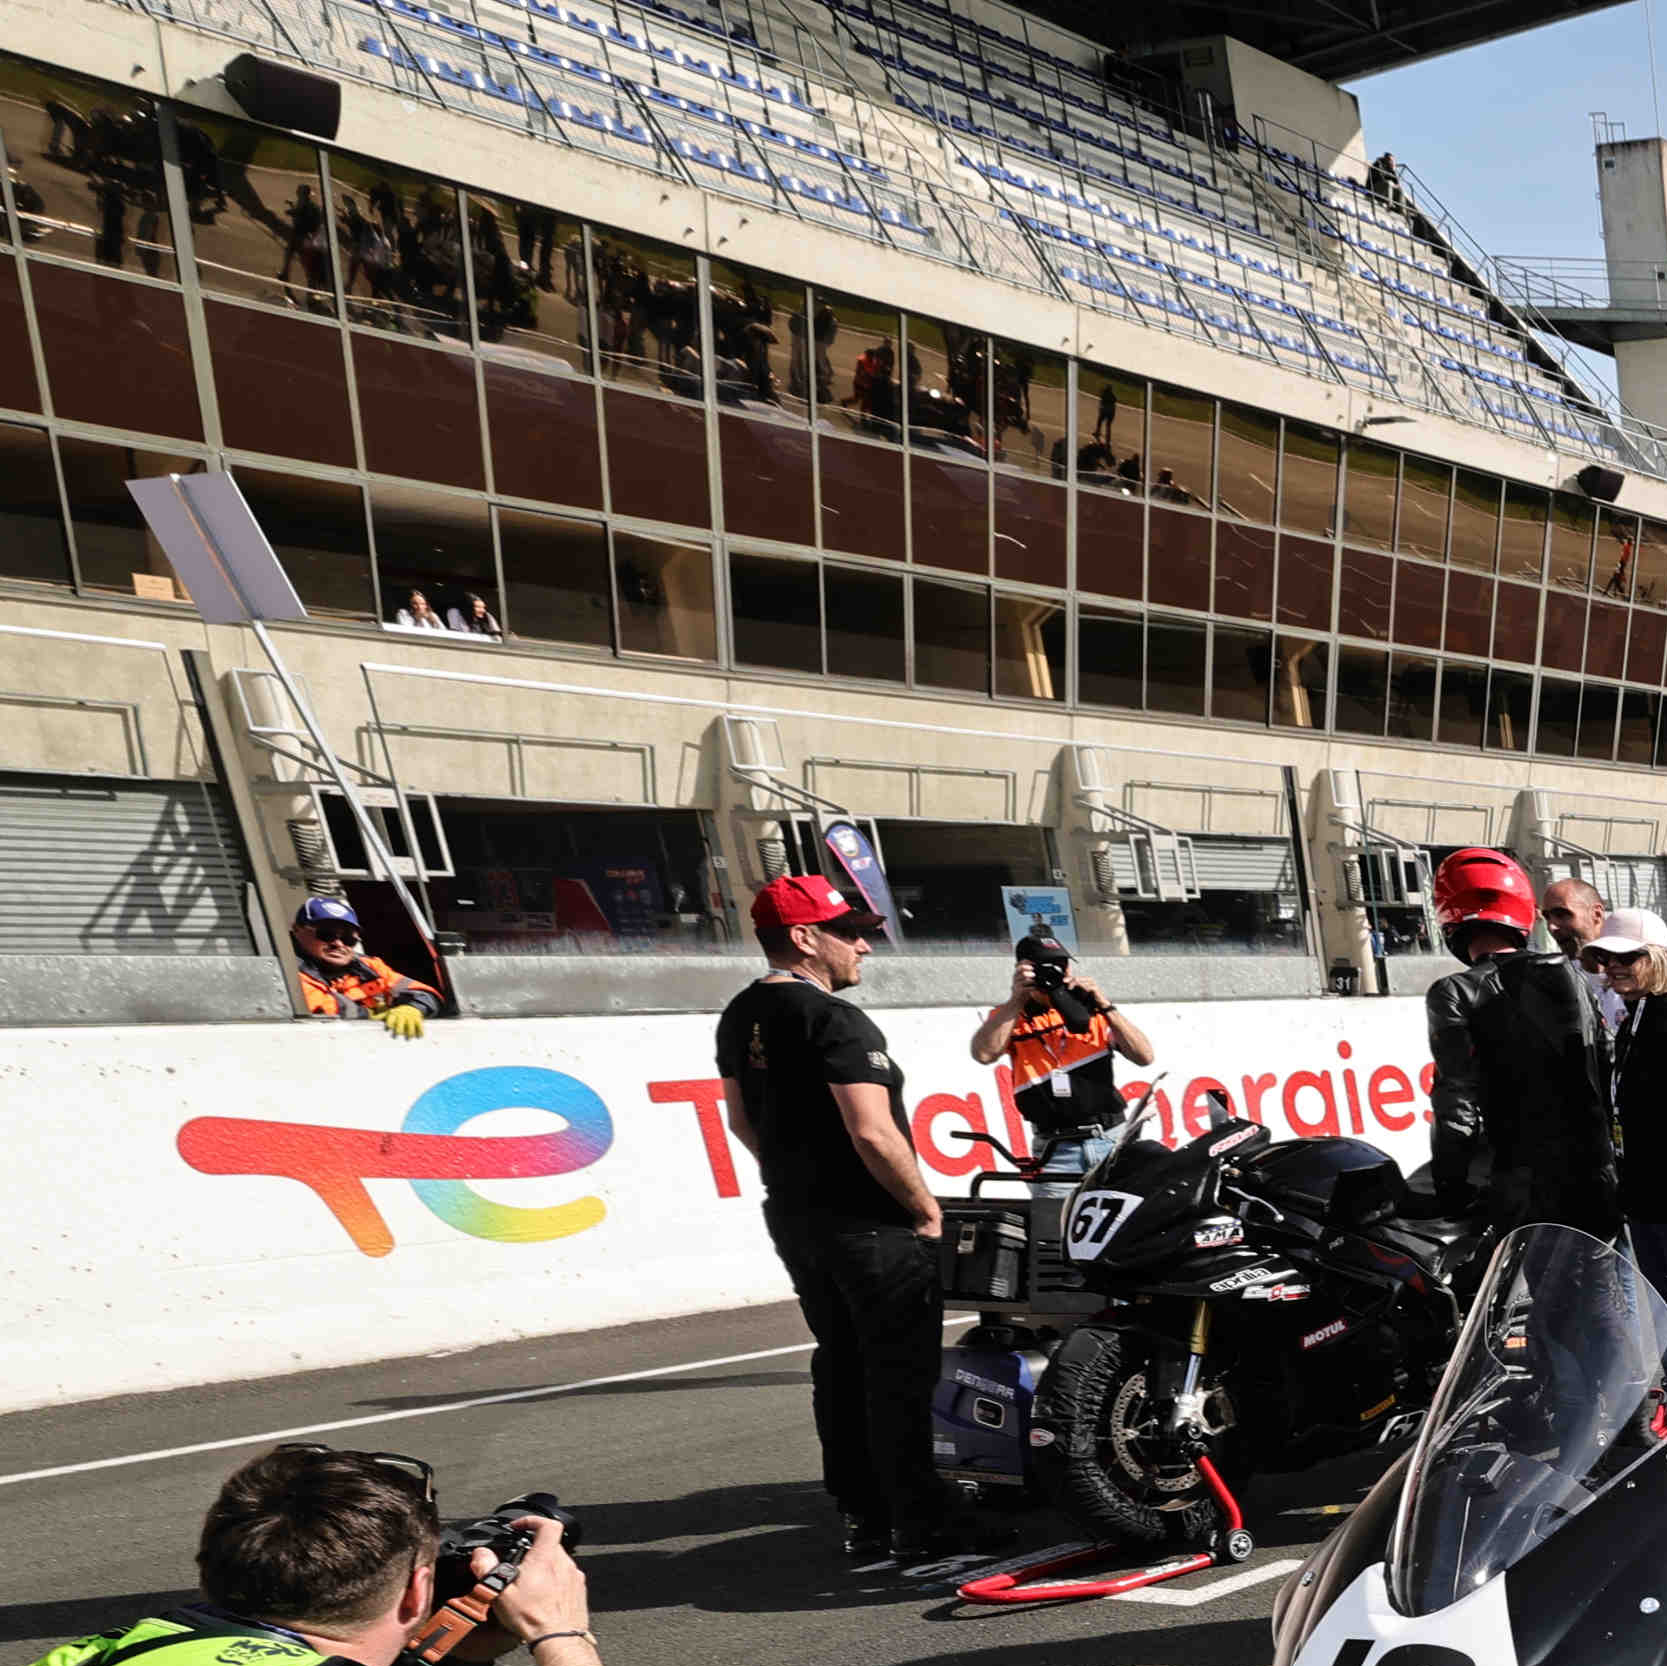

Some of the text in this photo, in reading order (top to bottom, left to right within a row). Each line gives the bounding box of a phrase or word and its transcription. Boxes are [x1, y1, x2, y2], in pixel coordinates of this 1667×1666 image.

[1335, 976, 1353, 991] 31
[1071, 1195, 1126, 1245] 67
[1200, 1227, 1242, 1244] AMA
[1211, 1269, 1270, 1292] aprilia
[1303, 1319, 1346, 1348] MOTUL
